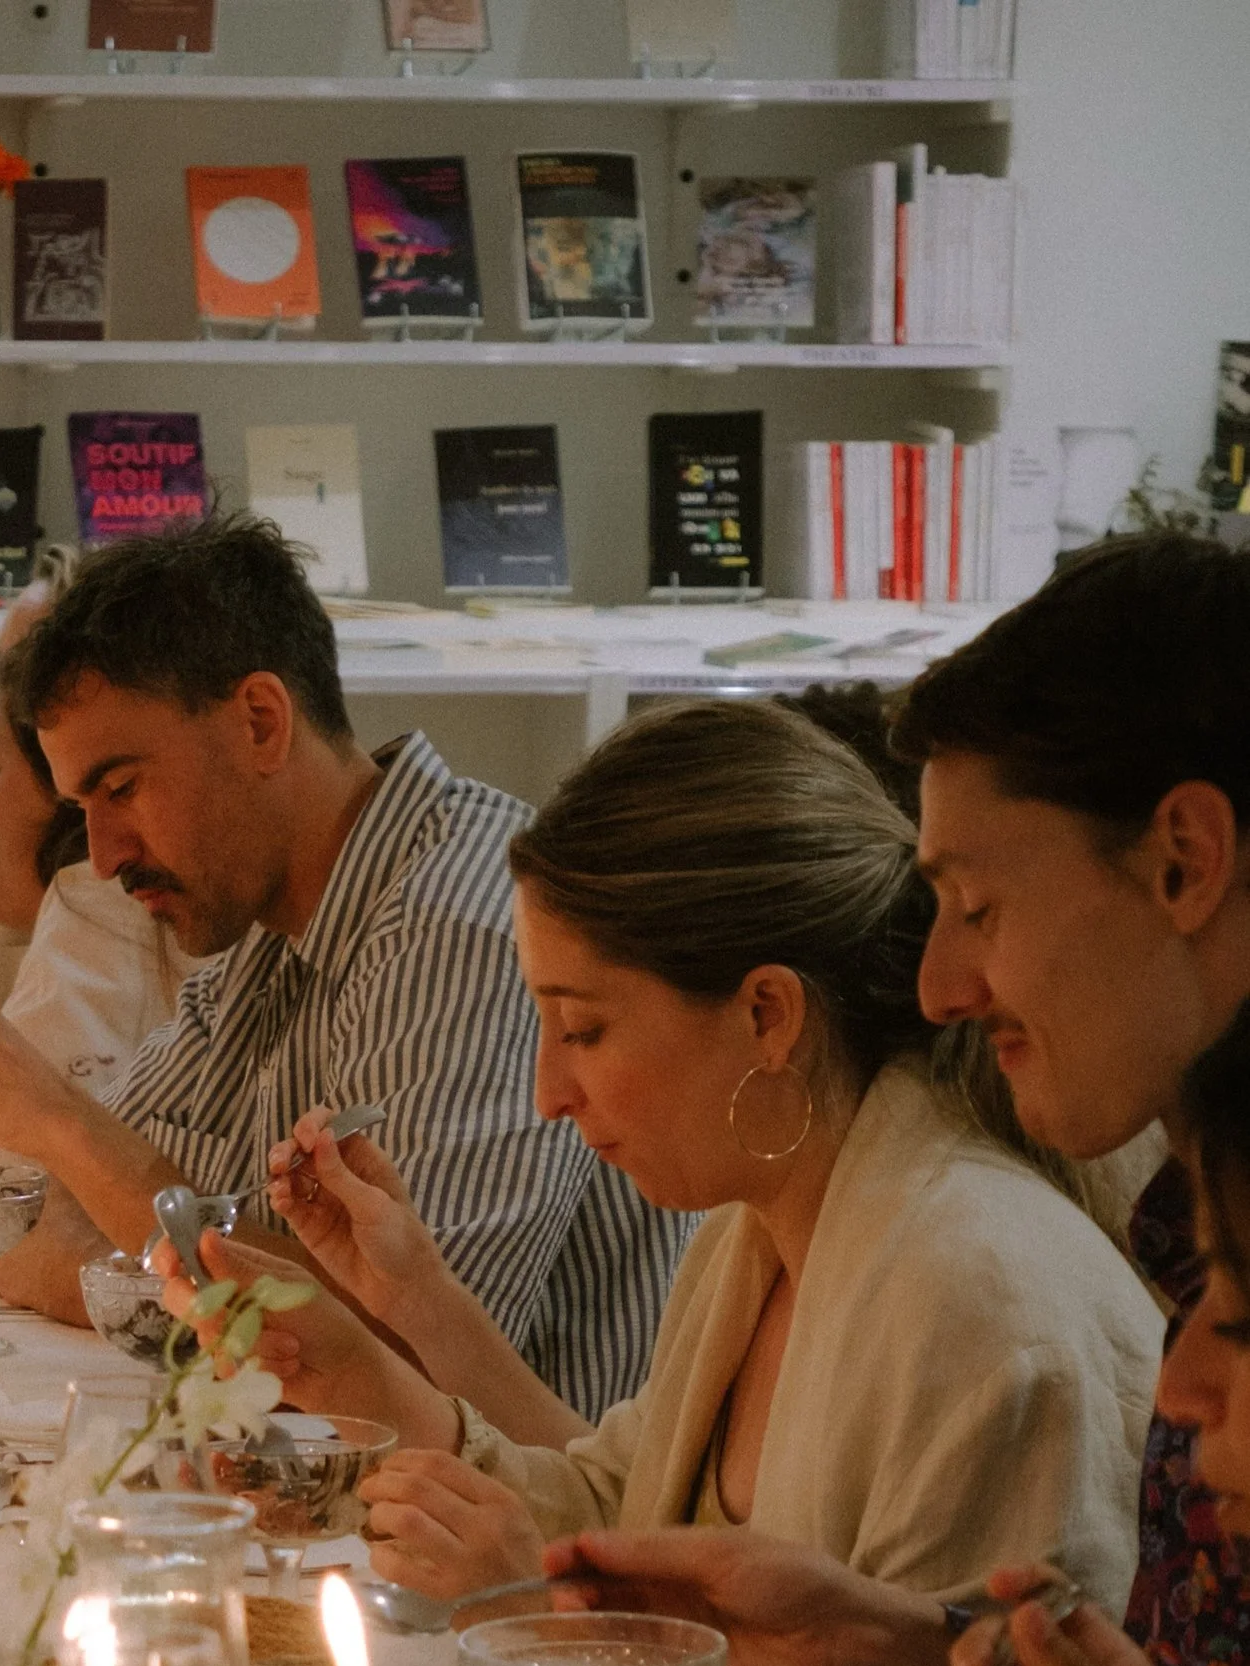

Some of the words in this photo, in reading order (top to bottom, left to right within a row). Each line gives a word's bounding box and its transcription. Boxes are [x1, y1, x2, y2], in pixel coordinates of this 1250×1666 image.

[86, 442, 197, 466] SOUTIF
[89, 468, 164, 491] MON
[91, 493, 205, 519] AMOUR
